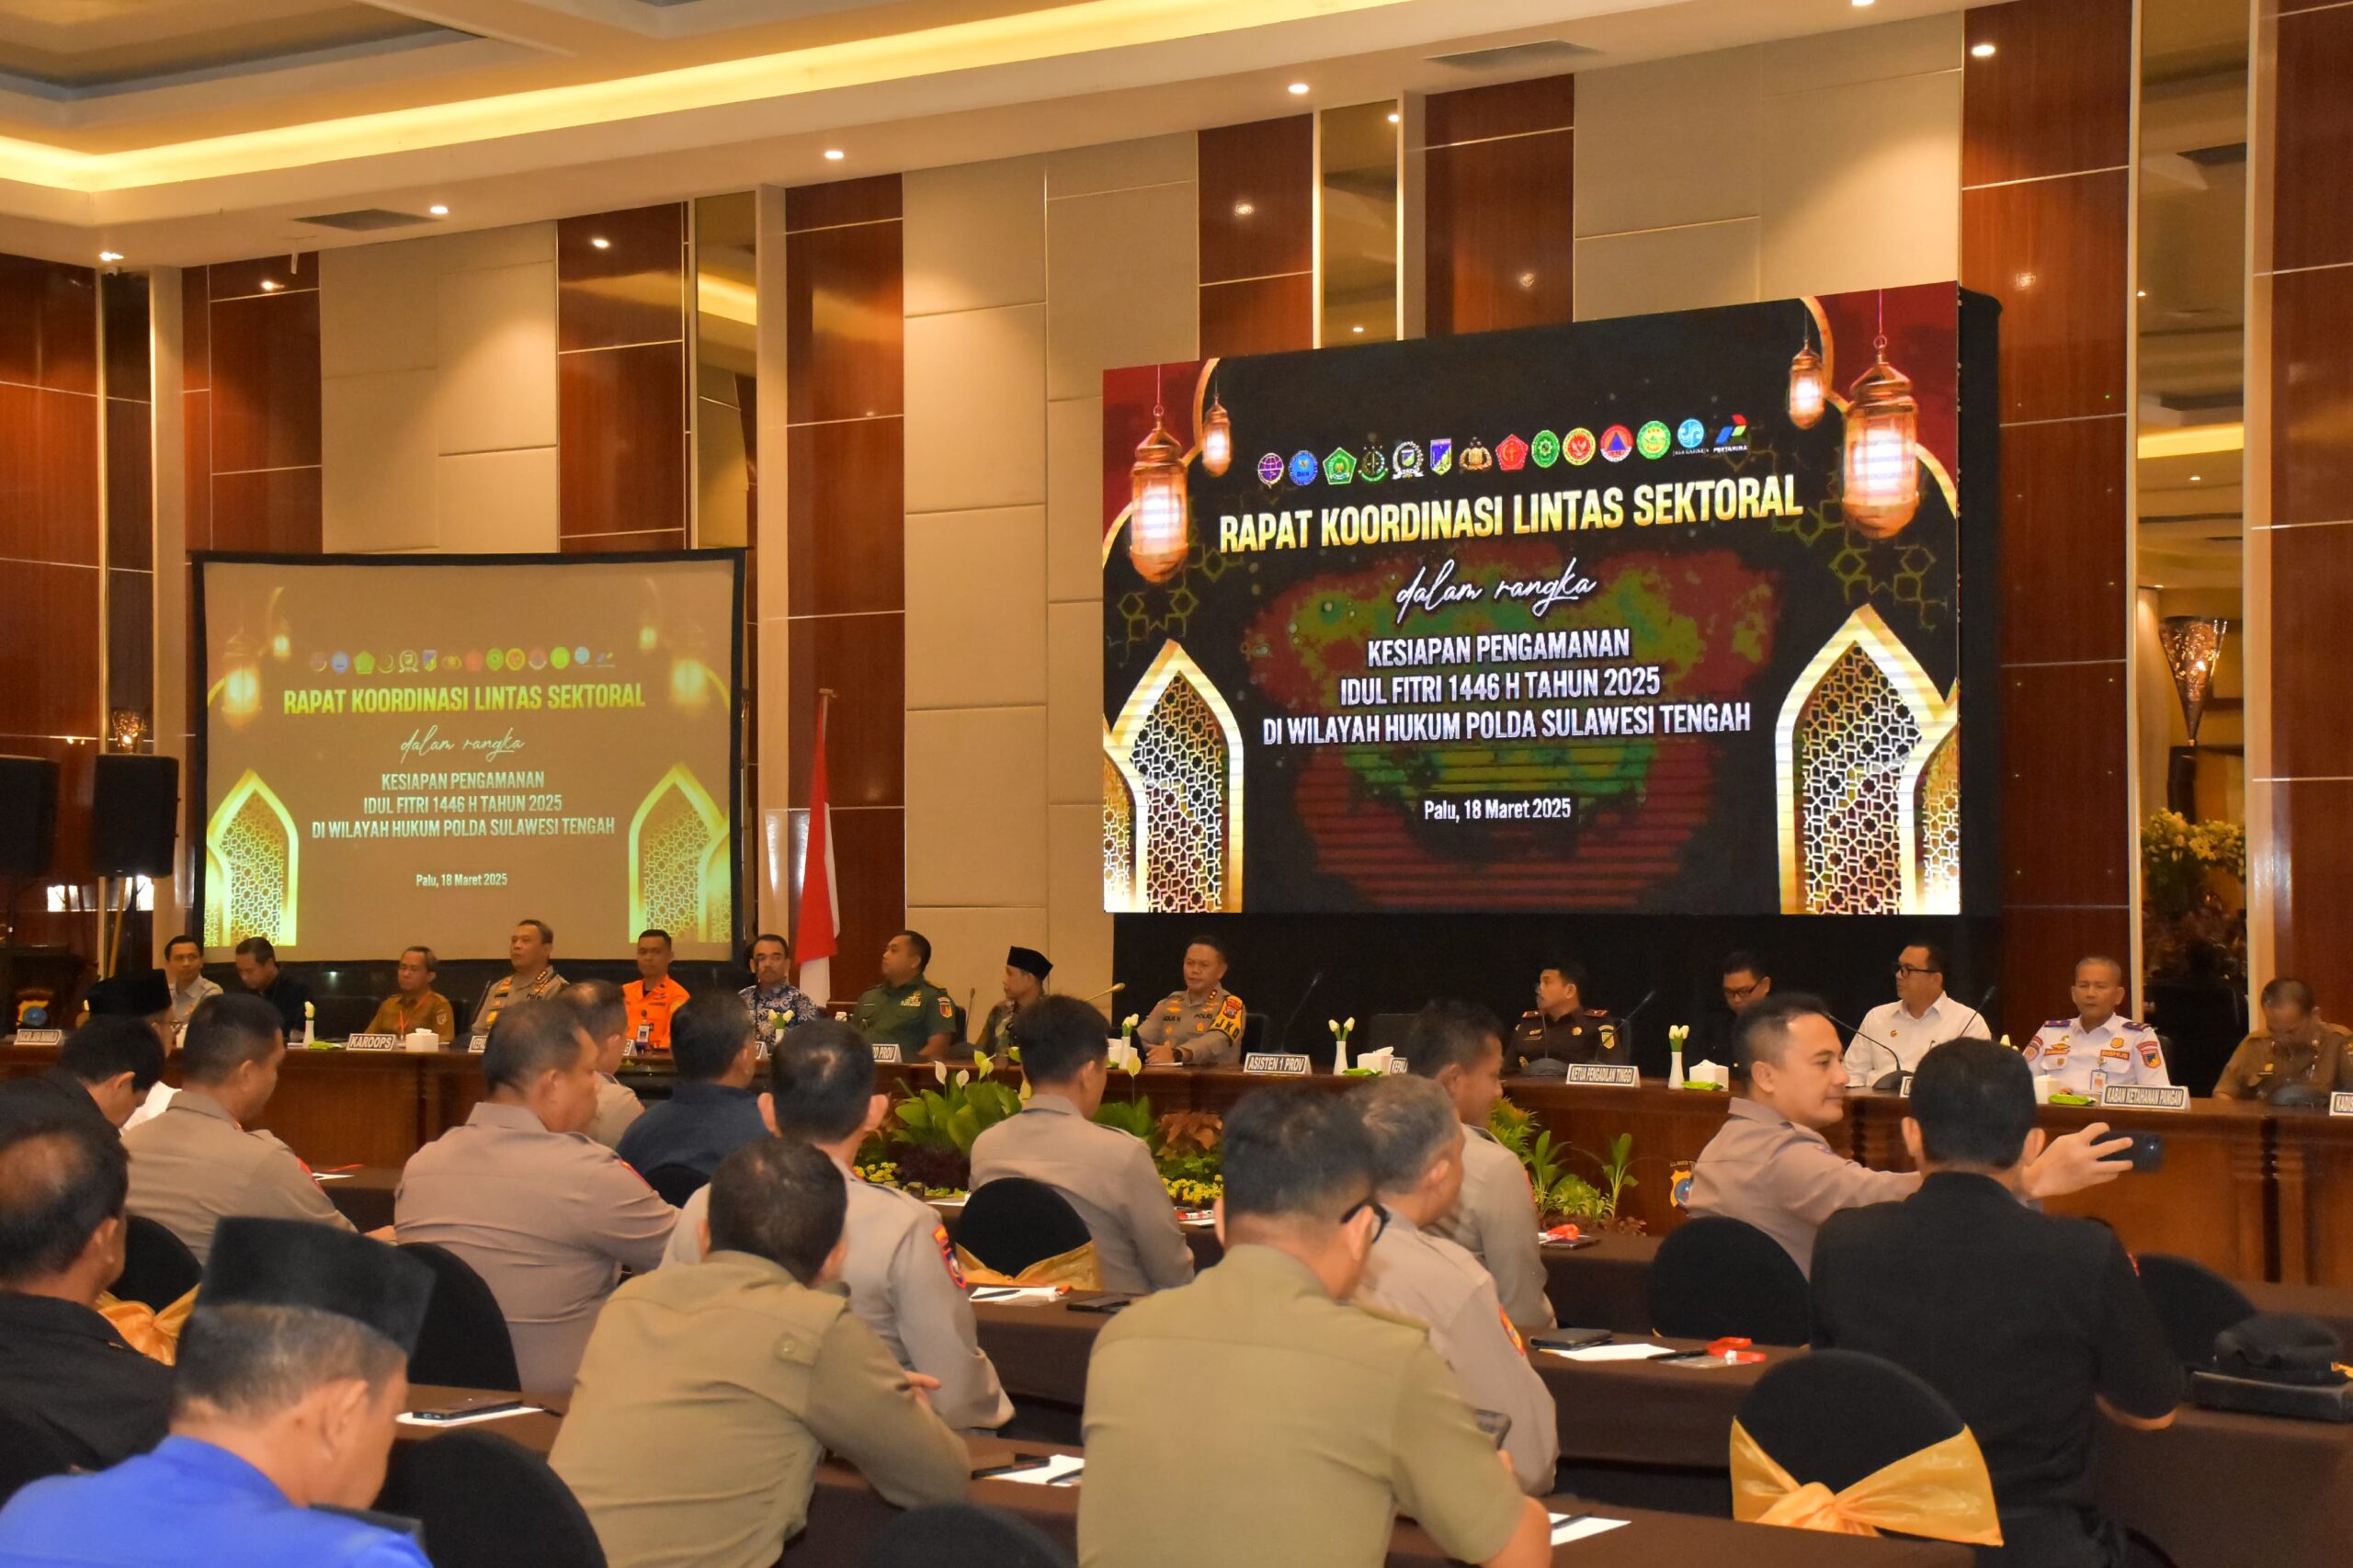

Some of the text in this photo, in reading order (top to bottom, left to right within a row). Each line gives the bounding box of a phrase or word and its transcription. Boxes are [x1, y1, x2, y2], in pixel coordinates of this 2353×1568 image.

[1220, 474, 1803, 552] RAPAT KOORDINASI LINTAS SEKTORAL
[1396, 557, 1597, 624] dalam rangka
[1368, 629, 1630, 667] KESIAPAN PENGAMANAN
[1340, 666, 1660, 706] IDUL FITRI 1446 H TAHUN 2025
[283, 683, 646, 715] RAPAT KOORDINASI LINTAS SEKTORAL
[1263, 702, 1750, 745] DI WILAYAH HUKUM POLDA SULAWESI TENGAH
[400, 724, 525, 764] dalam rangka
[381, 771, 544, 791] KESIAPAN PENGAMANAN
[364, 794, 563, 814] IDUL FITRI 1446 H TAHUN 2025
[1425, 798, 1571, 824] Palu, 18 Maret 2025
[312, 817, 616, 838] DI WILAYAH HUKUM POLDA SULAWESI TENGAH
[415, 873, 507, 888] Palu, 18 Maret 2025
[350, 1036, 392, 1048] KAROOPS
[879, 1046, 894, 1060] PROV
[1247, 1056, 1304, 1072] ASISTEN 1 PROV
[1392, 1059, 1407, 1074] KEPAL
[1571, 1066, 1633, 1083] KETUA PENGADILAN TINGGI
[2159, 1089, 2182, 1106] PANGAN
